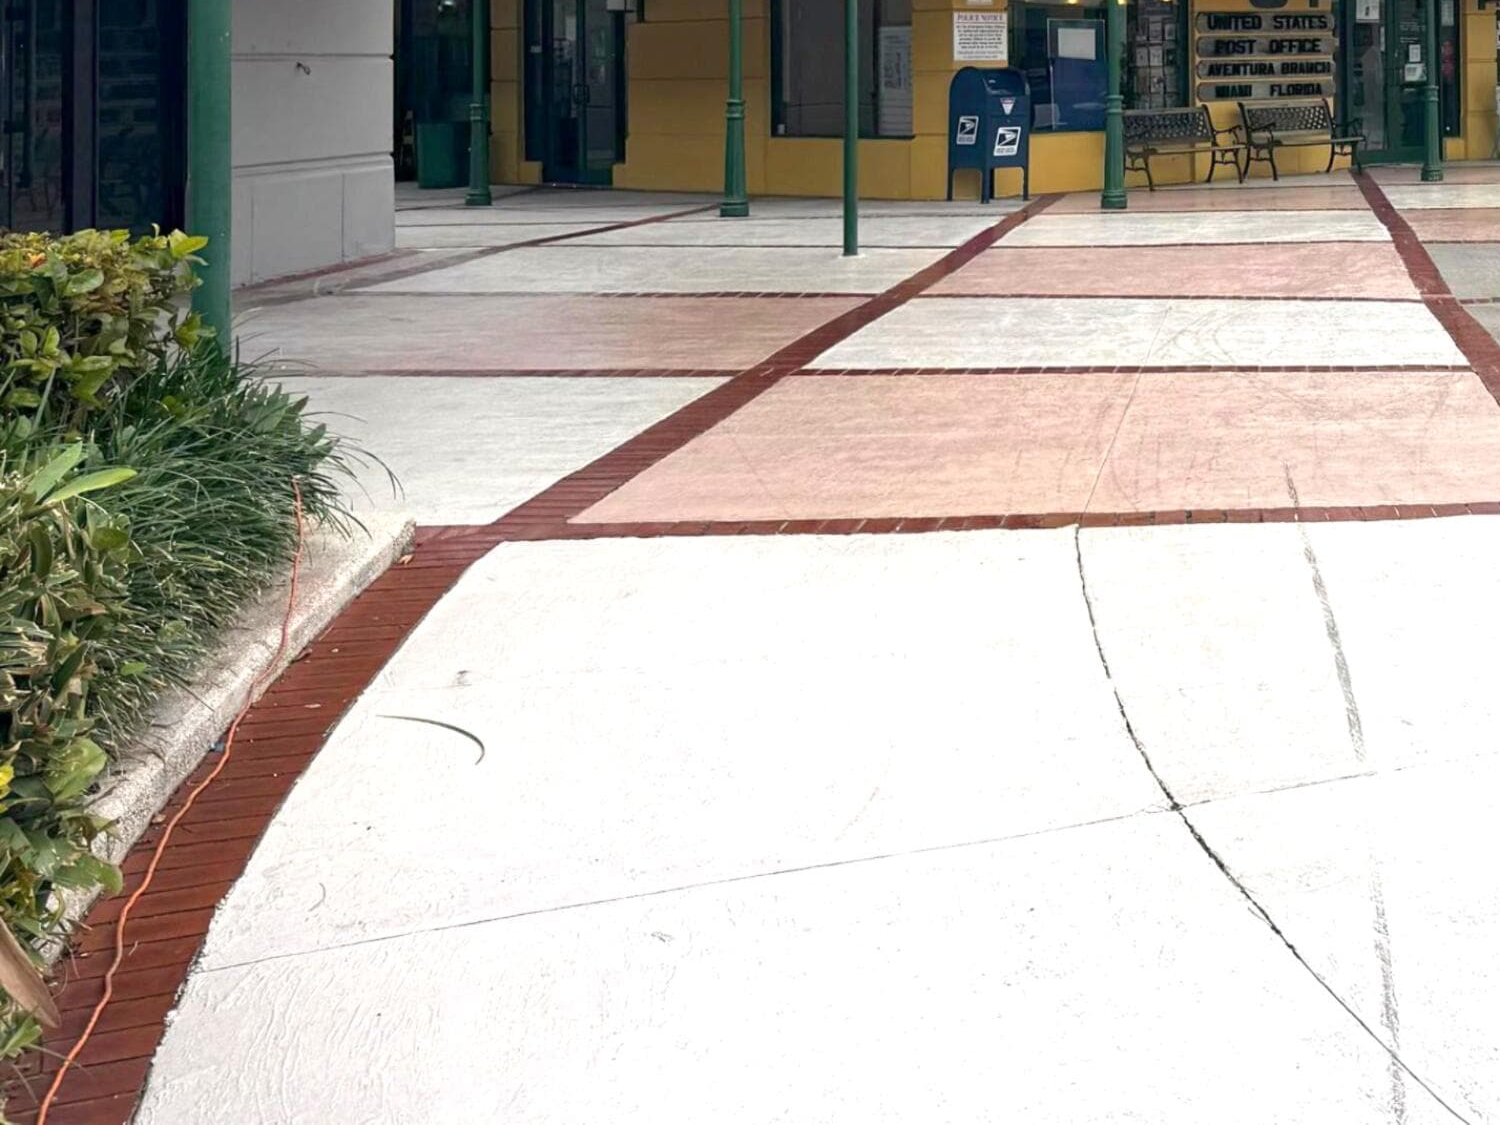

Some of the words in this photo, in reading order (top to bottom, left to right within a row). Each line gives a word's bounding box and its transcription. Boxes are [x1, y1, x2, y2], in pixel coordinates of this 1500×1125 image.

[1207, 15, 1262, 30] UNITED
[1273, 15, 1328, 29] STATES
[1214, 39, 1256, 54] POST
[1269, 39, 1321, 53] OFFICE
[1208, 62, 1275, 76] AVENTURA
[1281, 61, 1330, 74] BRANCH
[1215, 84, 1252, 97] MIAMI
[1270, 83, 1322, 96] FLORIDA
